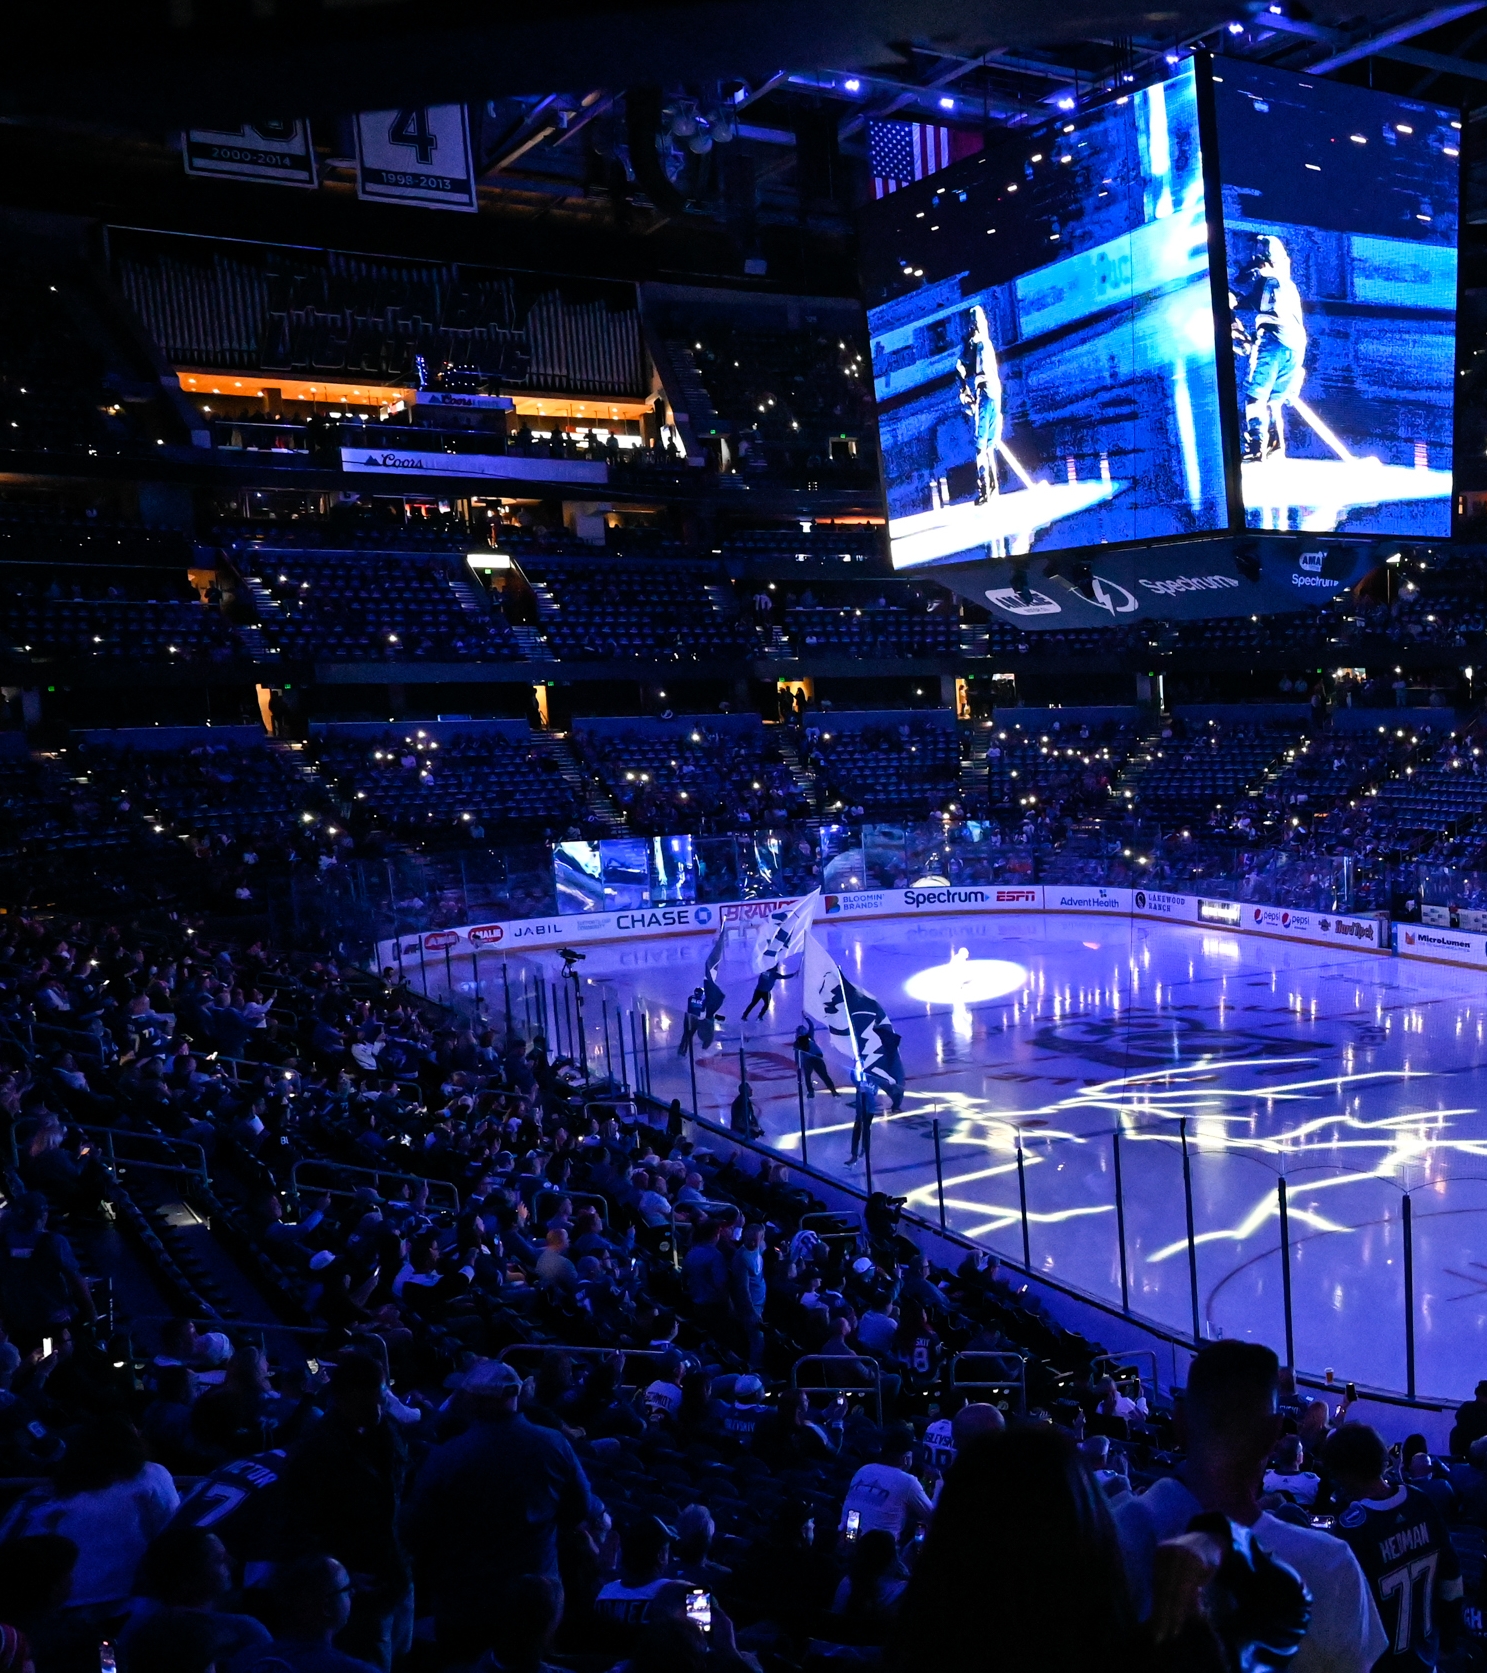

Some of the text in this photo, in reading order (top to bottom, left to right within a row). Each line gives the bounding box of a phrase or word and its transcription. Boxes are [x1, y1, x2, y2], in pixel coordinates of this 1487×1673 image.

[388, 107, 437, 165] 4
[211, 147, 292, 167] 2000-2014
[381, 171, 452, 190] 1998-2013
[442, 393, 472, 406] Coors
[381, 453, 424, 470] Coors
[1138, 575, 1234, 597] Spectrum
[842, 893, 885, 904] BLOOMIN'
[904, 889, 985, 909] Spectrum
[996, 890, 1036, 903] ESPN
[1060, 897, 1119, 909] AdventHealth
[1148, 894, 1186, 905] LAKEWOOD
[843, 903, 878, 911] BRANDS
[1148, 902, 1171, 913] RANCH
[617, 910, 690, 930] CHASE
[1263, 909, 1281, 922] pepsi
[1292, 914, 1310, 927] pepsi
[514, 924, 563, 937] JABIL
[1335, 920, 1356, 936] Hard
[1355, 923, 1374, 941] Rock
[1418, 934, 1470, 948] MicroLumen
[1378, 1549, 1440, 1655] 77
